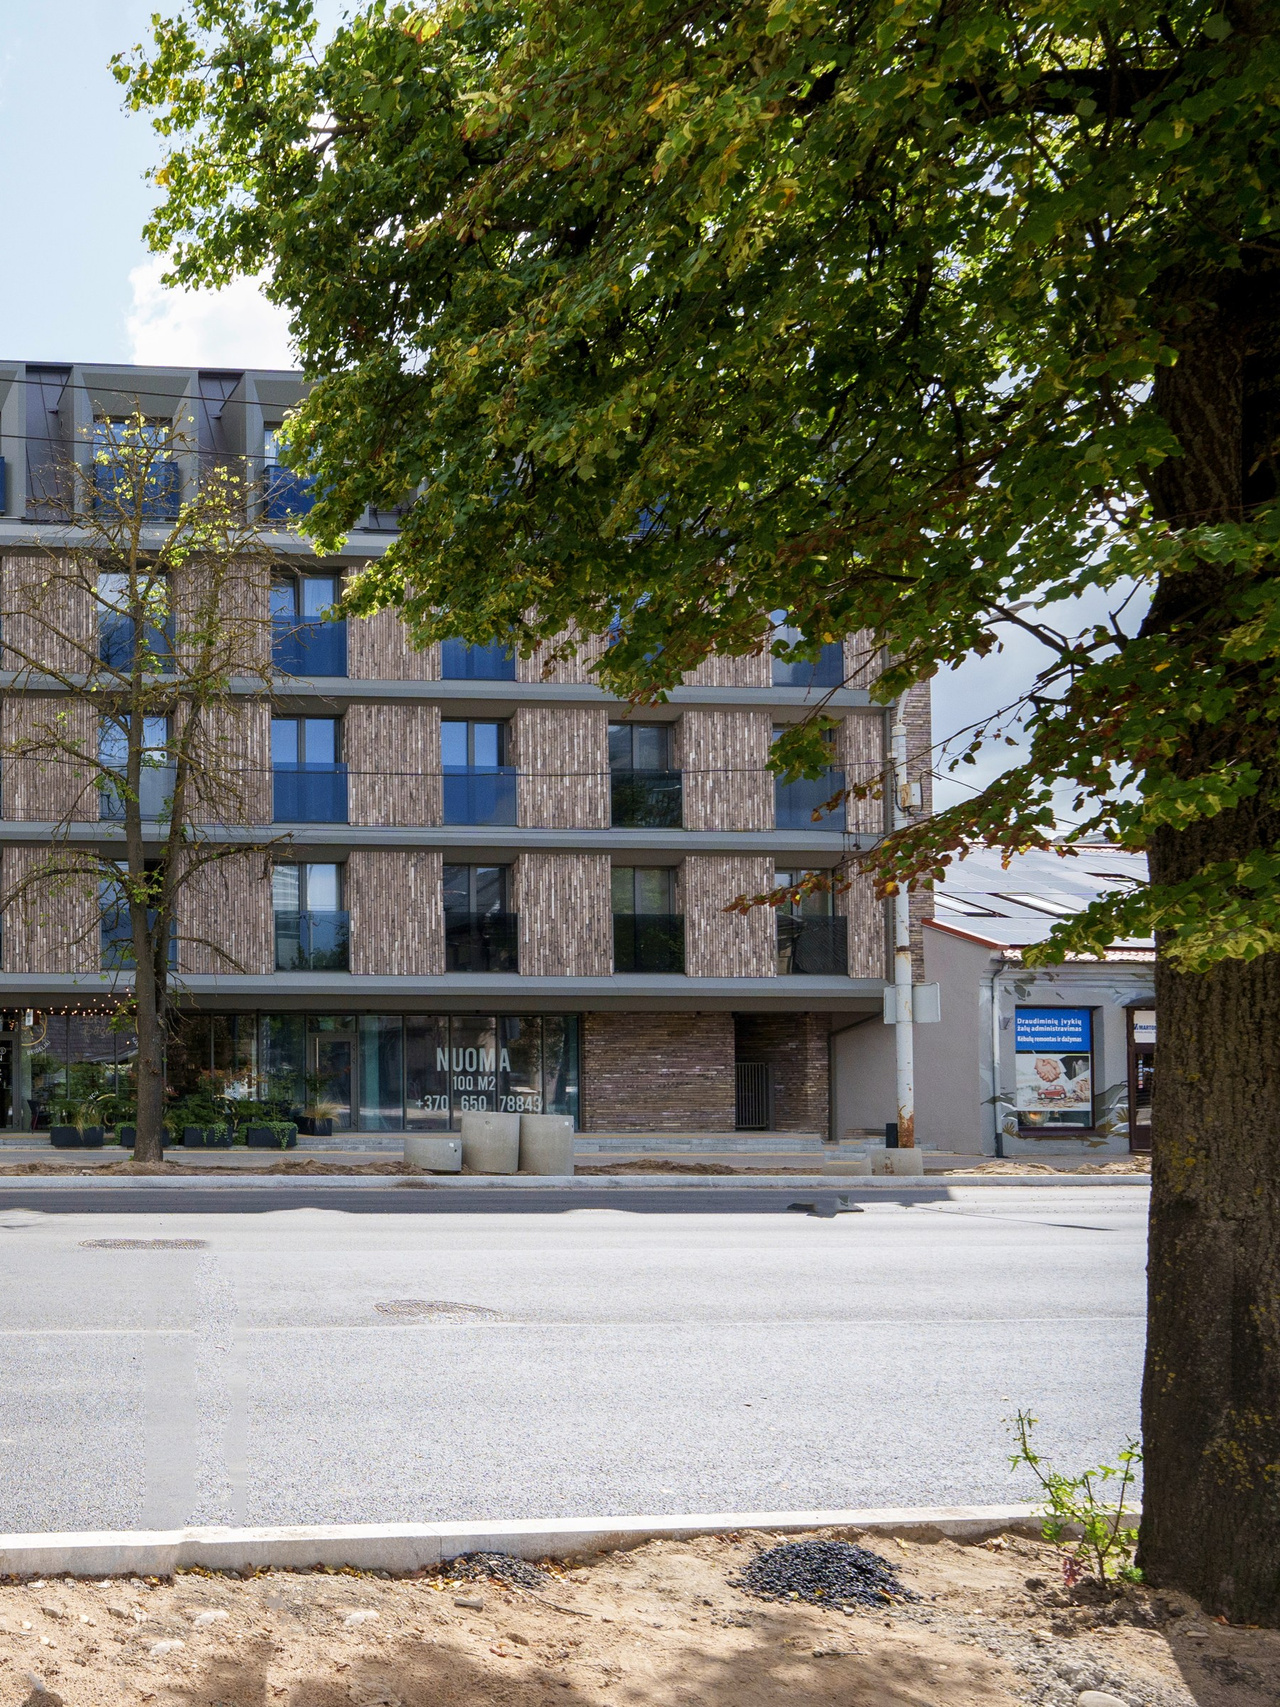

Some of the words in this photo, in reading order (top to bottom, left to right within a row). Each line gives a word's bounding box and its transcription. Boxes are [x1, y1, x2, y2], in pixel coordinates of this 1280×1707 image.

[1017, 1018, 1058, 1026] Draudiminių
[1061, 1018, 1082, 1026] įvykių
[1017, 1025, 1030, 1033] žalų
[436, 1047, 511, 1072] NUOMA
[452, 1076, 474, 1091] 100
[477, 1076, 496, 1091] M2
[415, 1095, 449, 1112] +370
[461, 1095, 487, 1112] 650
[500, 1095, 542, 1112] 78843
